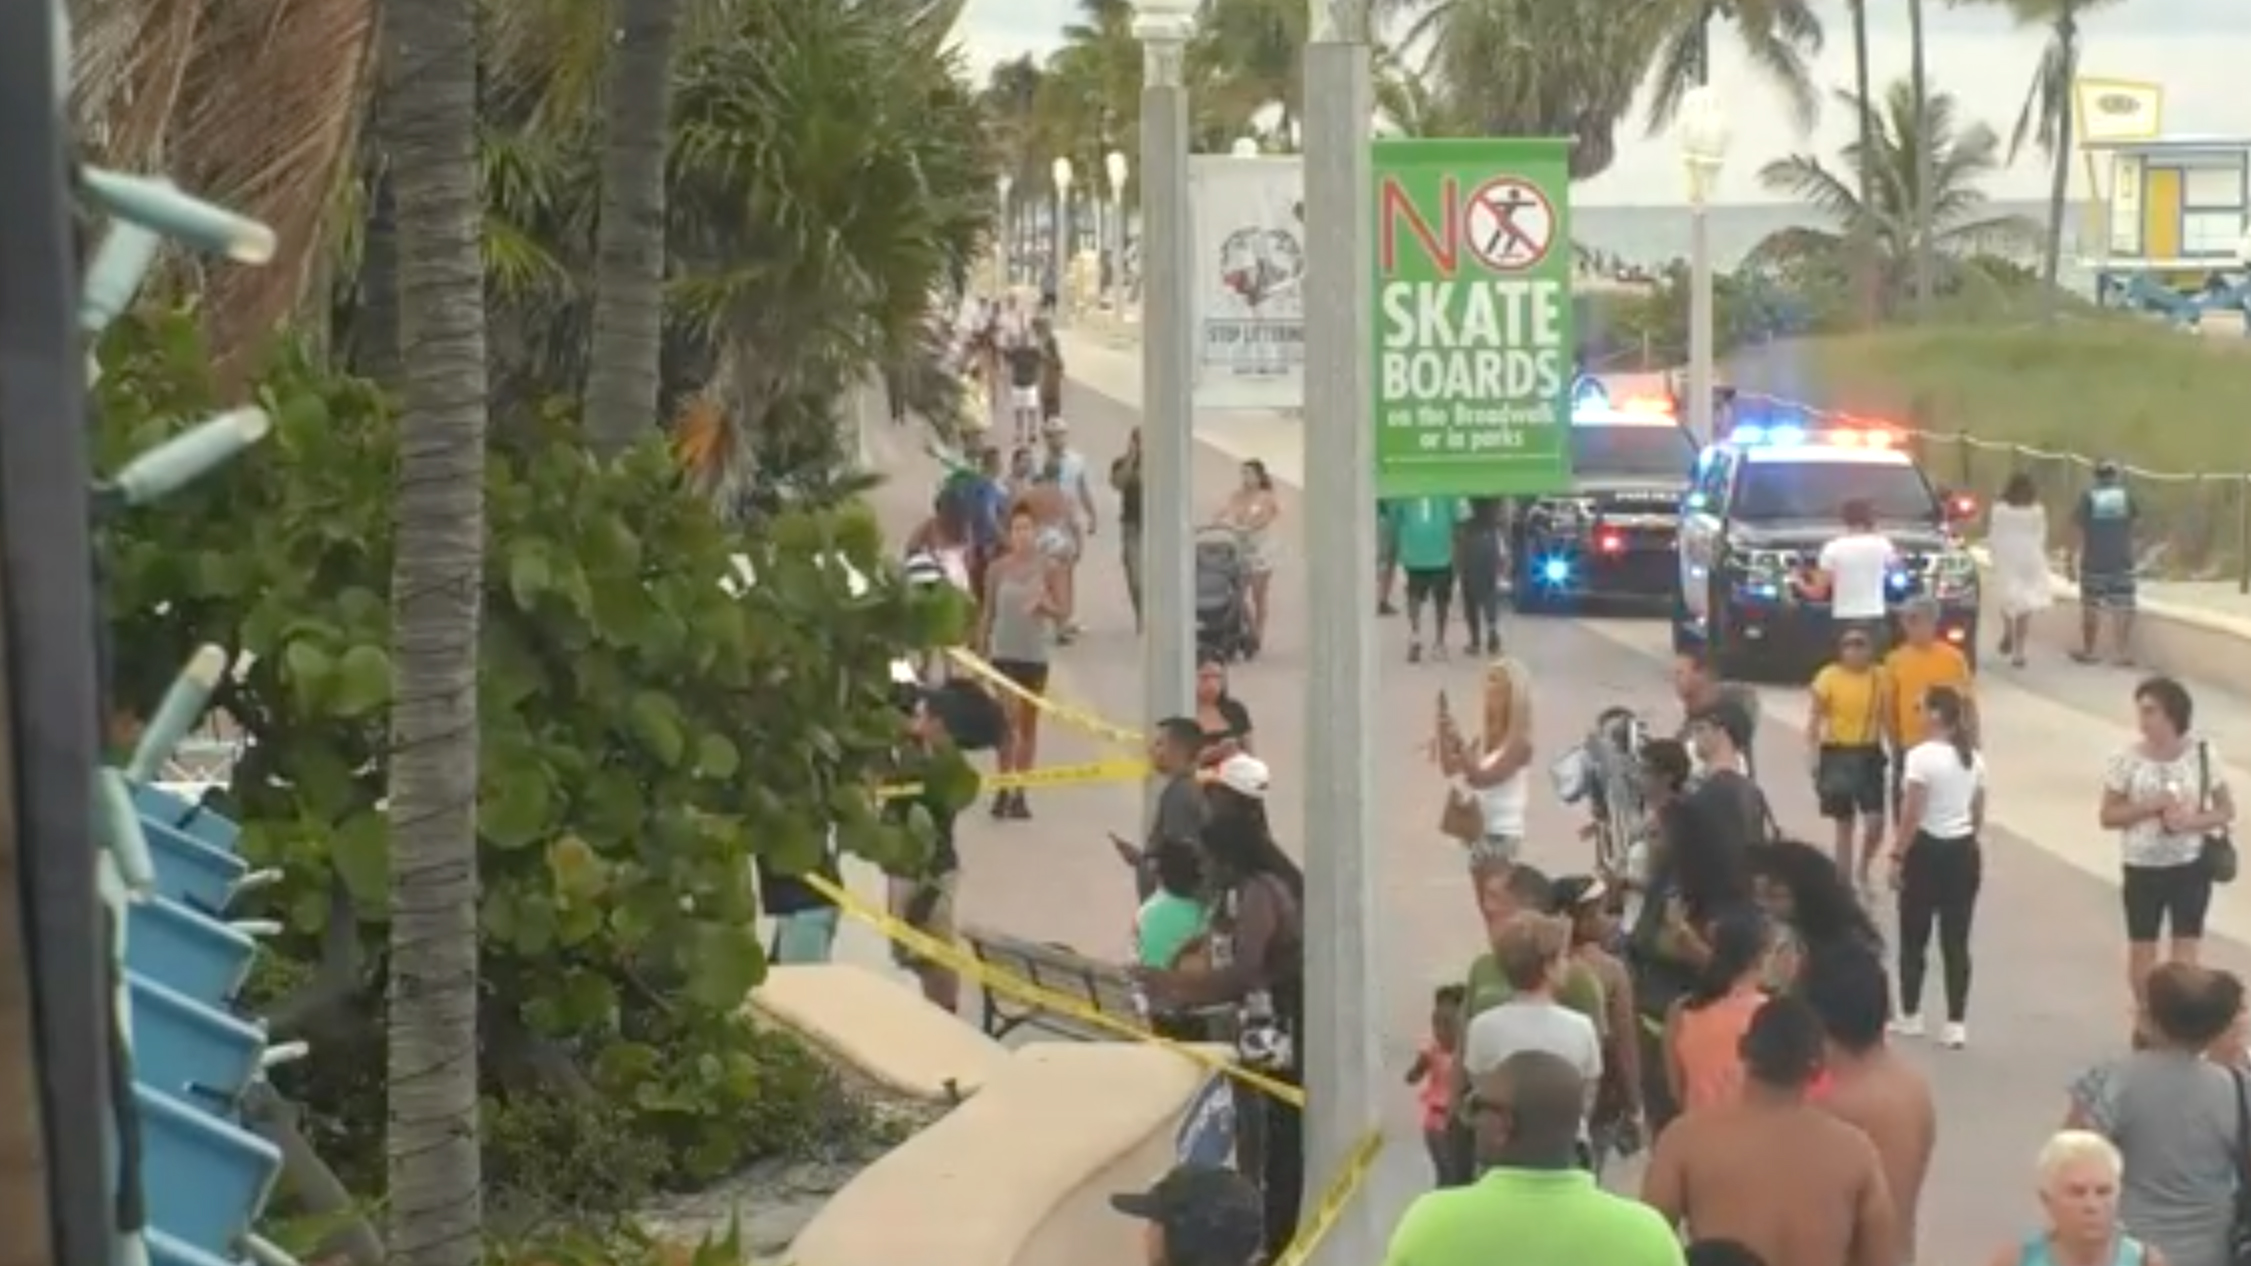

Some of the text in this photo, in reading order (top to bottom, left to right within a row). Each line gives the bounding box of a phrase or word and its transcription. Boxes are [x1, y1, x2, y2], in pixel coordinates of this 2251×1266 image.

[1382, 281, 1561, 348] SKATE
[1207, 325, 1240, 343] STOP
[1382, 350, 1561, 401] BOARDS
[1387, 409, 1412, 427] on
[1418, 404, 1448, 427] the
[1419, 425, 1524, 452] or in parks
